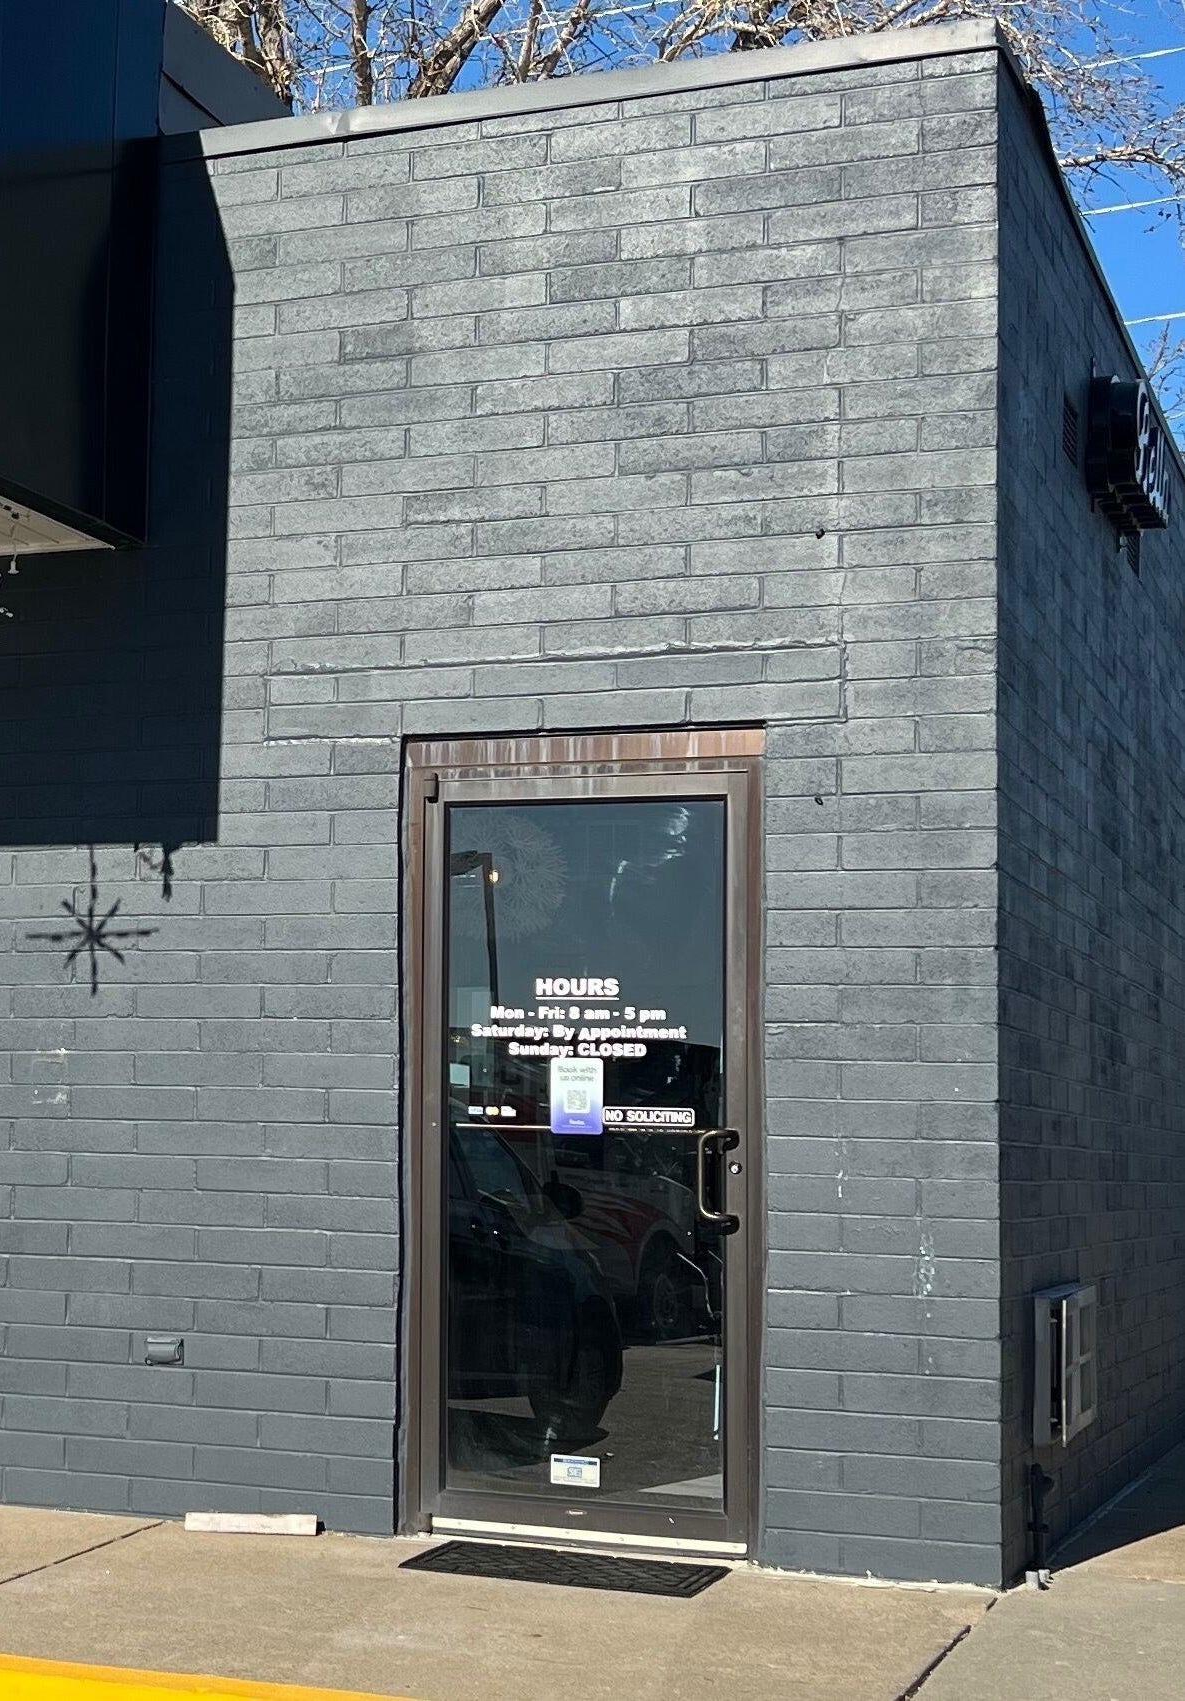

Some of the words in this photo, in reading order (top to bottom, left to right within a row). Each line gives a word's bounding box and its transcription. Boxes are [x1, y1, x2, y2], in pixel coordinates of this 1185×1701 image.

[535, 977, 620, 996] HOURS
[490, 1005, 525, 1020] Mon
[538, 1005, 566, 1020] Fri:
[568, 1006, 581, 1020] 8
[583, 1008, 611, 1020] am
[624, 1006, 636, 1020] 5
[639, 1008, 667, 1023] pm
[471, 1023, 550, 1041] Saturday:
[552, 1024, 576, 1041] By
[577, 1024, 688, 1041] Appointment
[508, 1041, 575, 1058] Sunday:
[577, 1042, 648, 1057] CLOSED
[557, 1065, 577, 1074] Book
[578, 1065, 598, 1074] with
[571, 1074, 595, 1082] online
[604, 1109, 624, 1123] NO
[626, 1110, 692, 1124] SOLICITING
